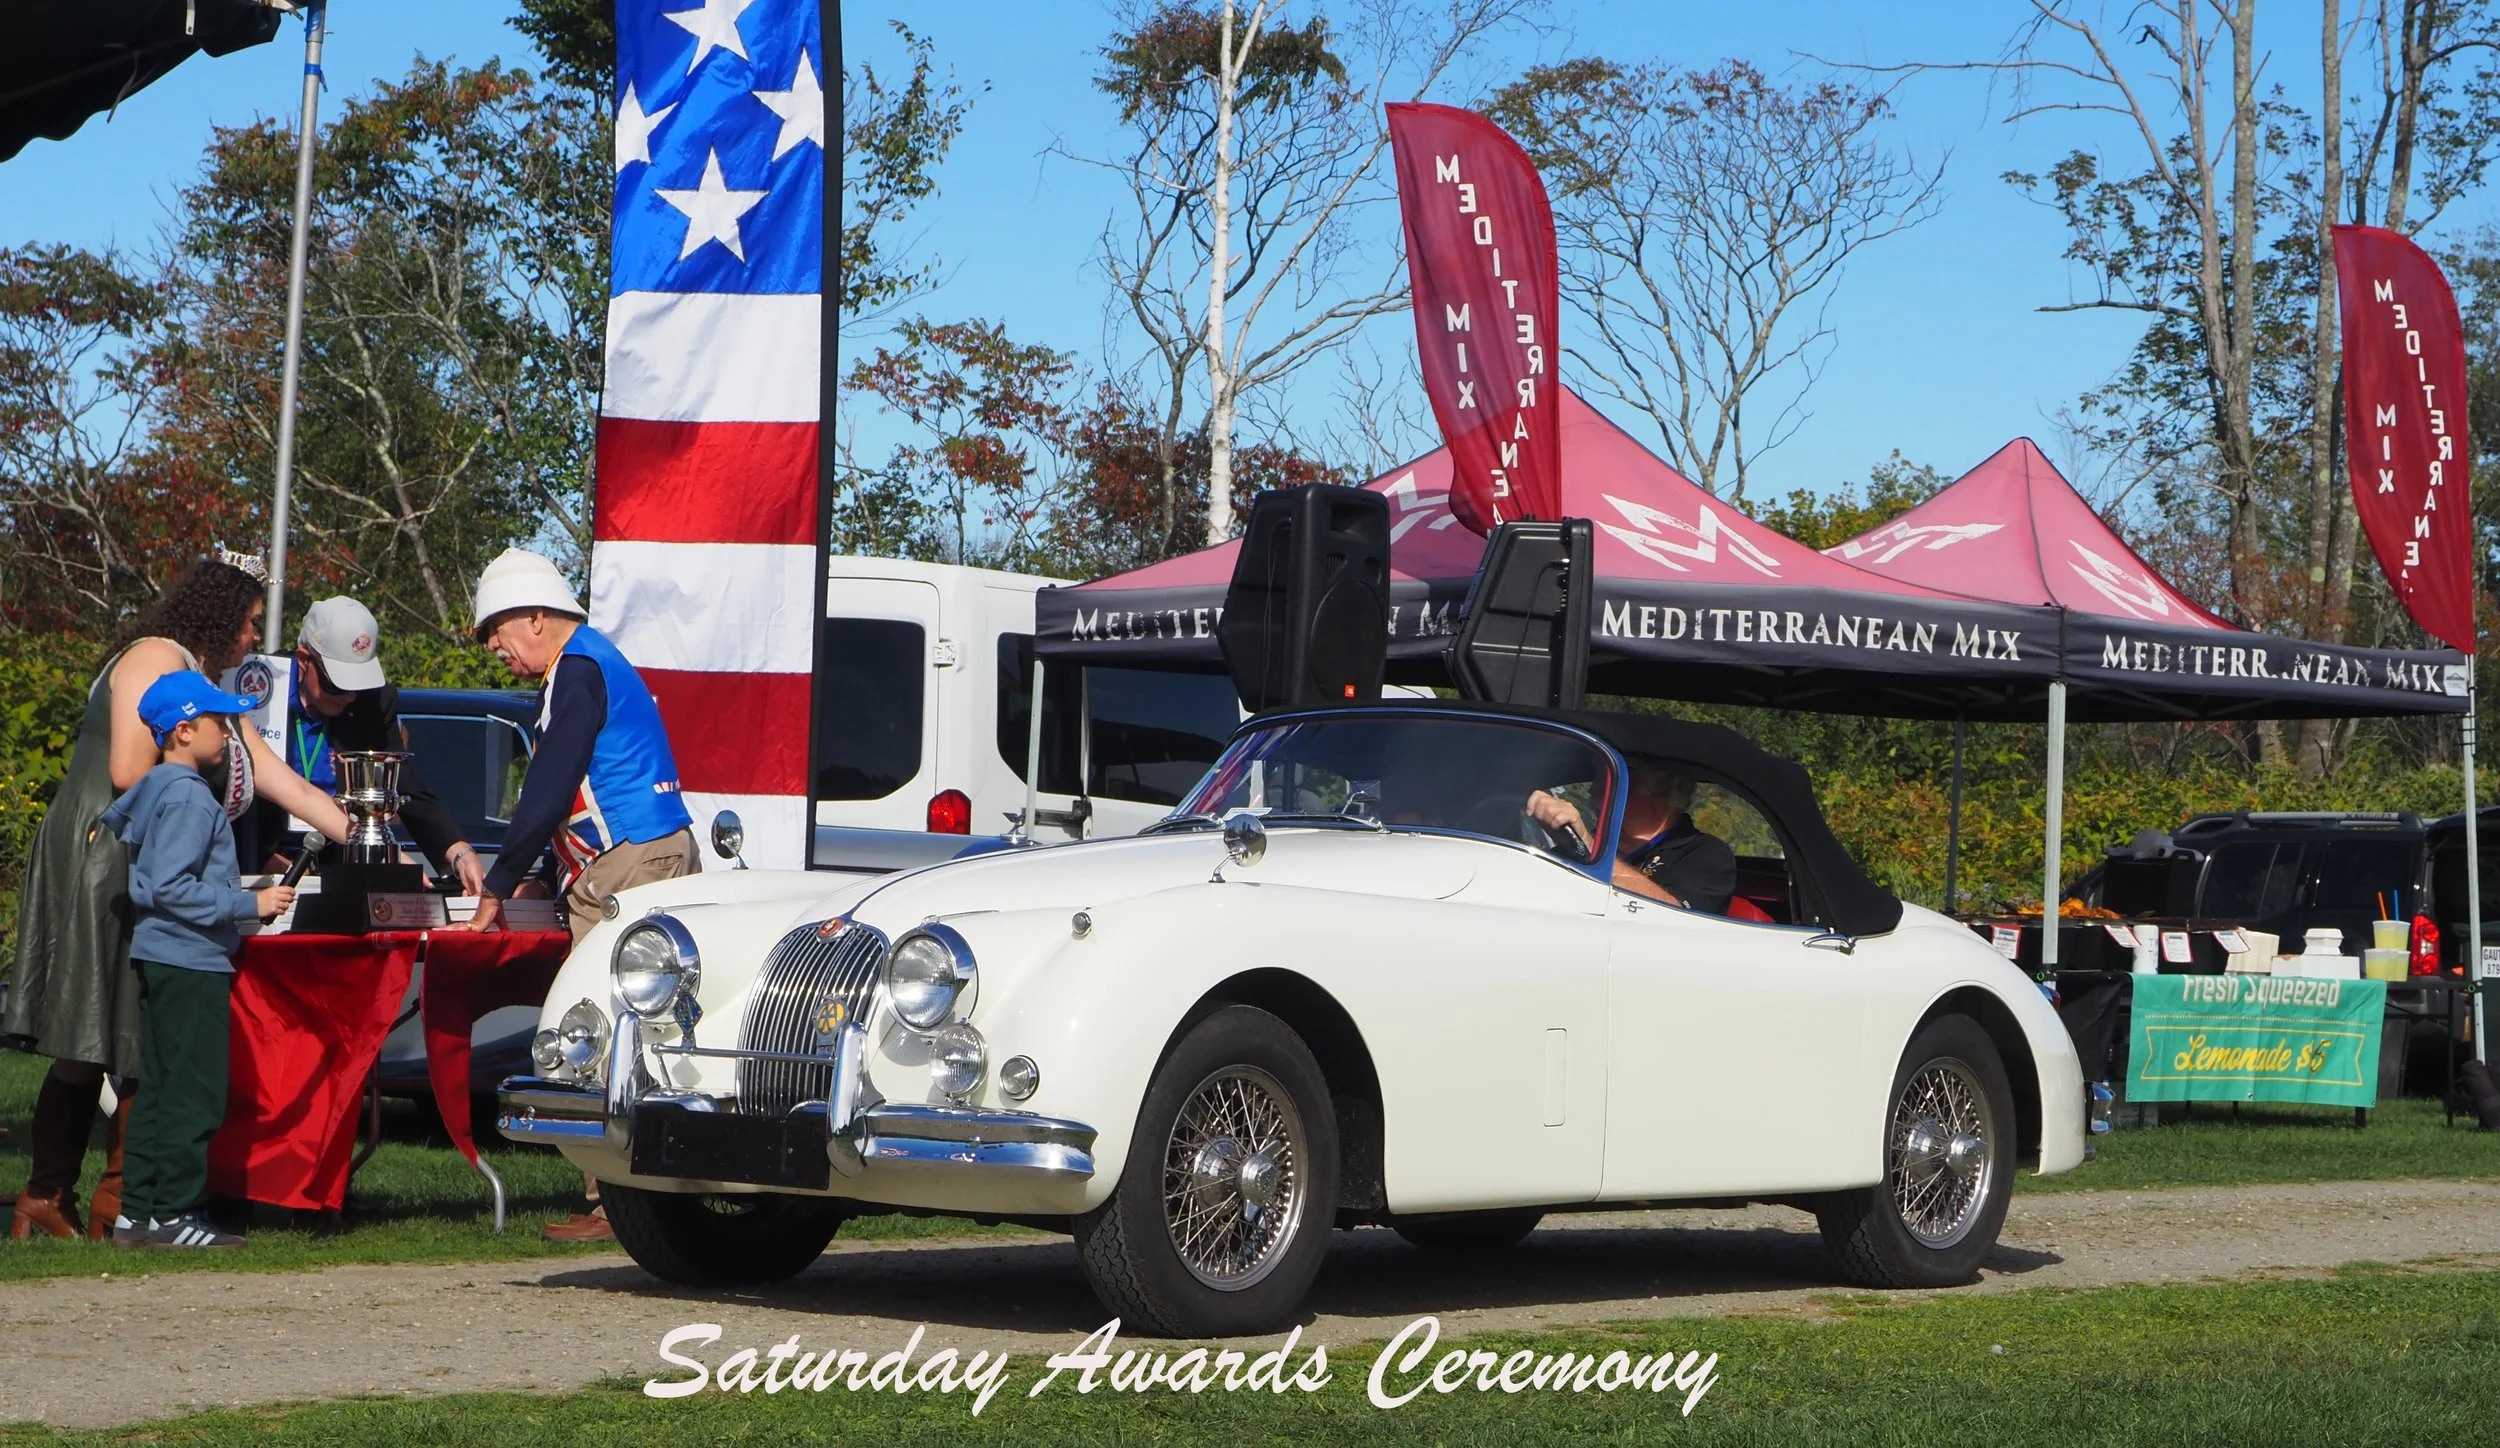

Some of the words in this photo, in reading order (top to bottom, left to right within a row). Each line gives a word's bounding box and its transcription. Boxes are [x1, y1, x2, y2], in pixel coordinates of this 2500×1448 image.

[1601, 599, 1938, 654] MEDITERRANEAN
[1950, 621, 2021, 661] MIX
[2101, 634, 2372, 688] MEDITERRNEAN
[2386, 656, 2443, 693] MIX
[256, 725, 281, 740] lace
[2174, 1034, 2293, 1073] Lemonade
